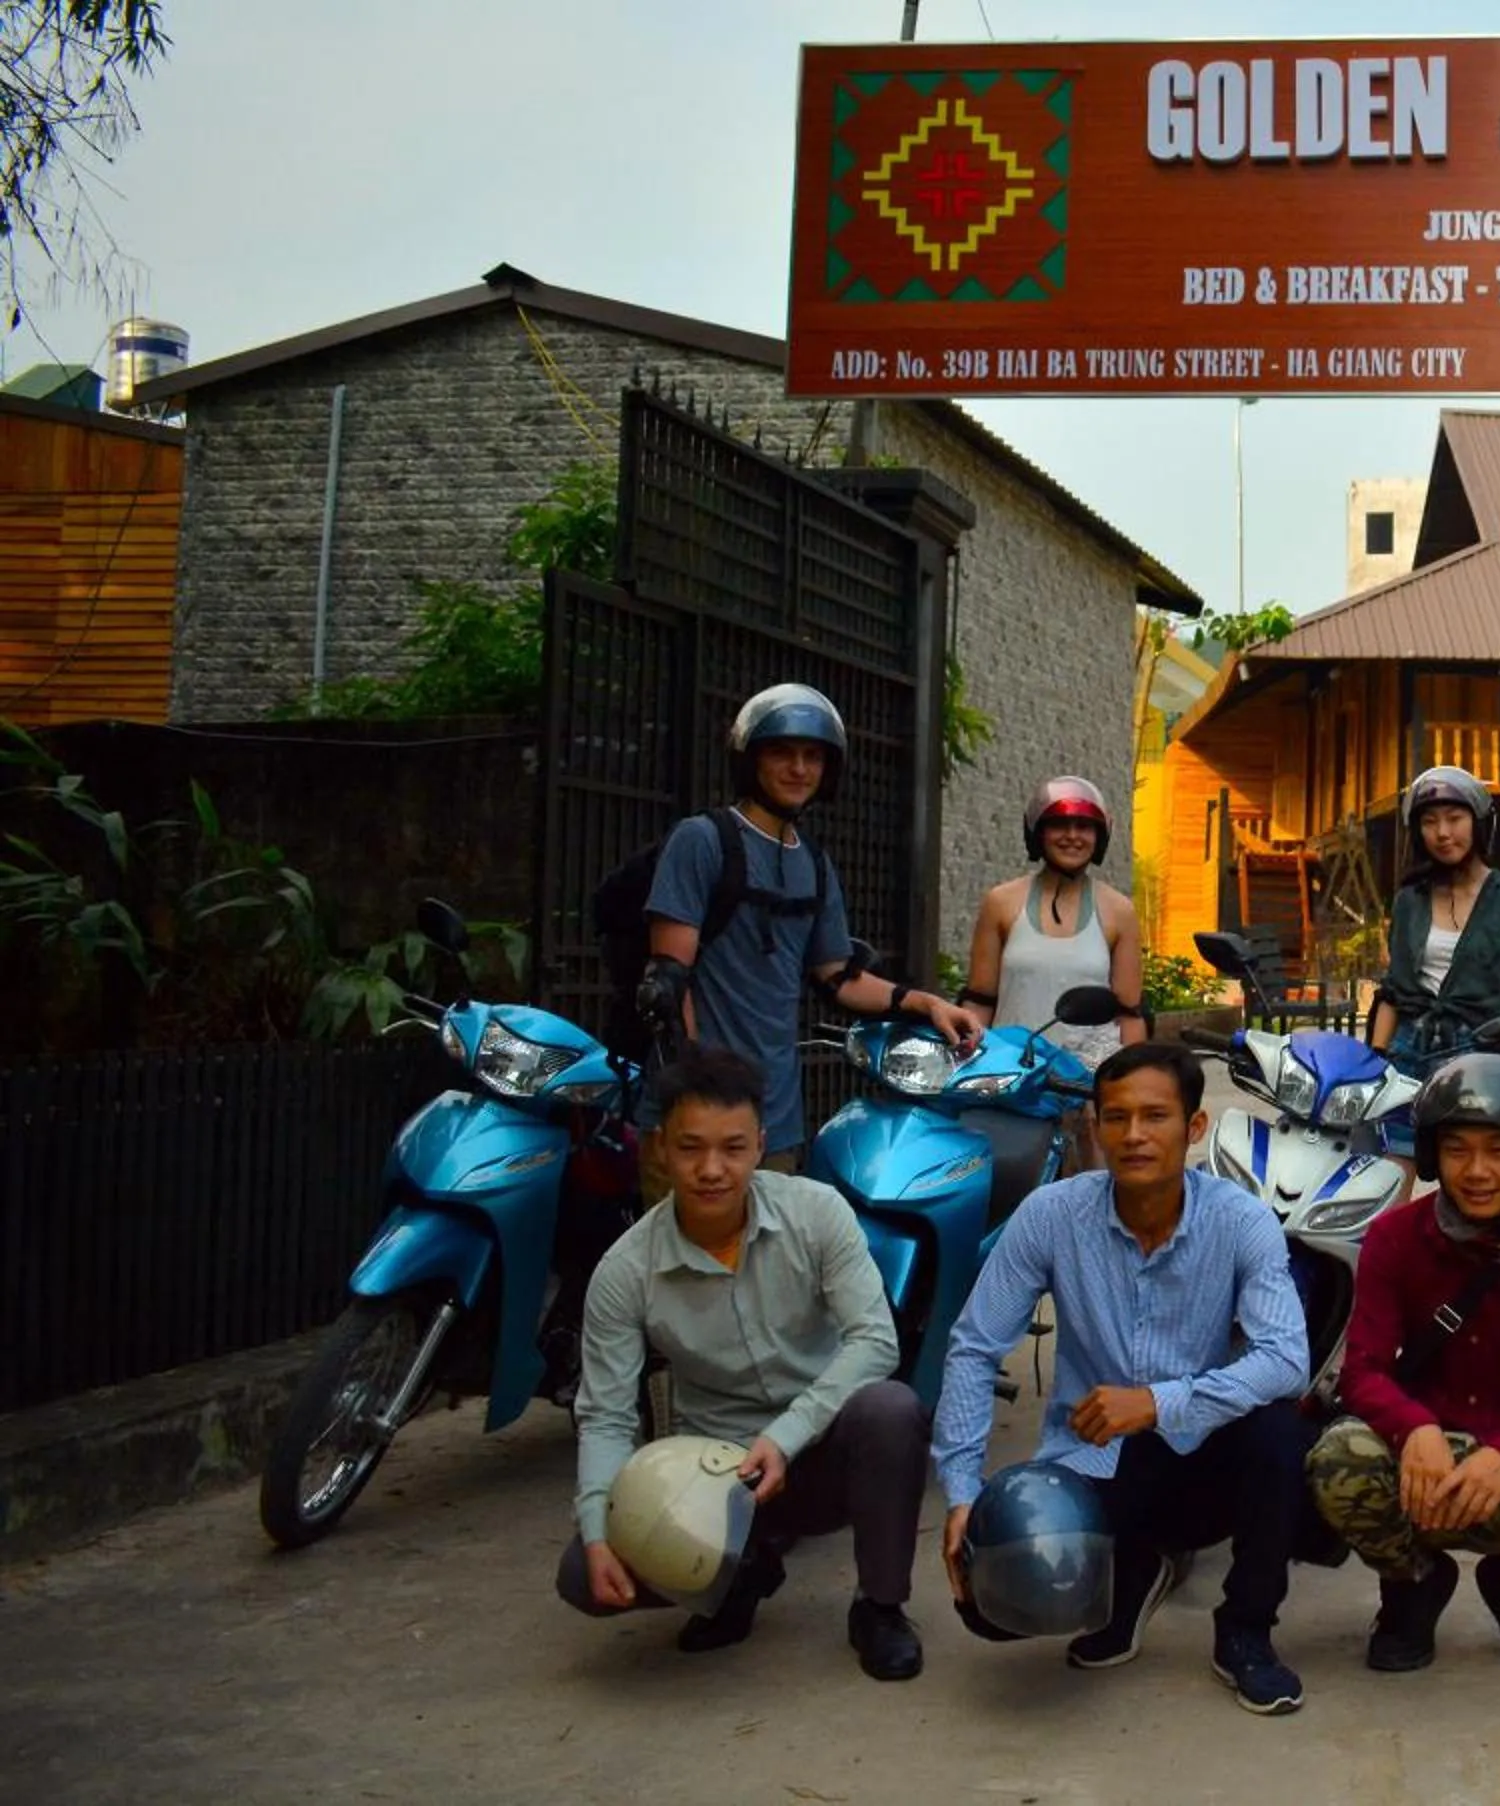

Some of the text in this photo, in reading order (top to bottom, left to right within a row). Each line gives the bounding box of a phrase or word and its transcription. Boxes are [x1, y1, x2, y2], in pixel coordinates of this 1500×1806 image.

[1146, 54, 1448, 162] GOLDEN
[1183, 267, 1245, 305] BED
[1254, 267, 1278, 305] &
[1287, 265, 1469, 305] BREAKFAST
[831, 350, 886, 379] ADD:
[895, 350, 933, 378] No.
[941, 350, 989, 378] 39B
[996, 350, 1038, 378] HAI
[1046, 350, 1077, 377] BA
[1085, 349, 1165, 378] TRUNG
[1173, 348, 1265, 378] STREET
[1286, 348, 1320, 378] HA
[1327, 348, 1402, 378] GIANG
[1410, 347, 1467, 378] CITY
